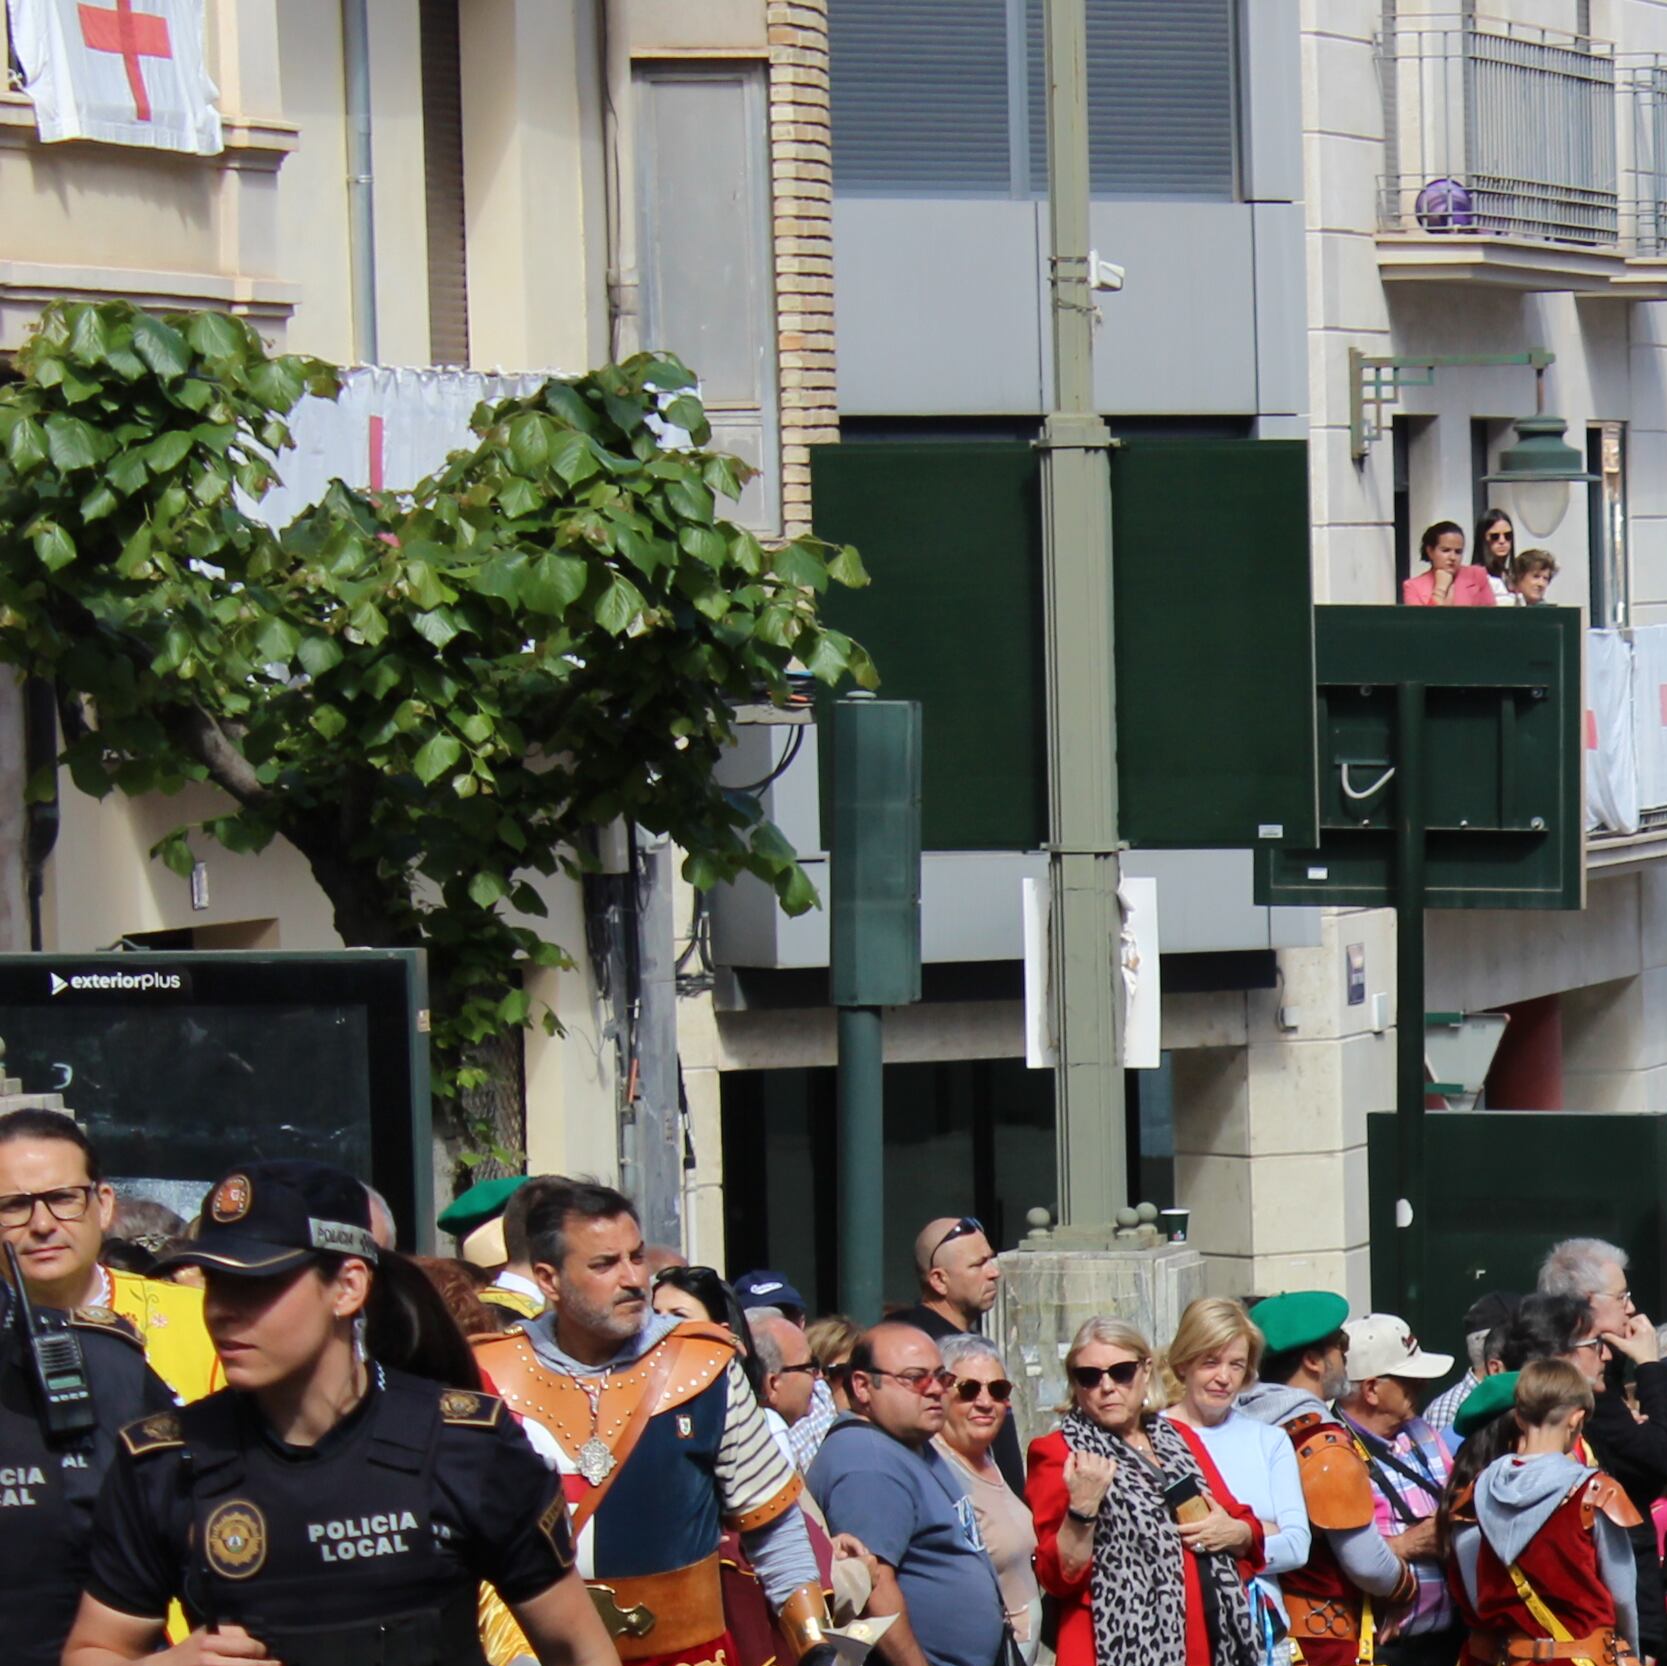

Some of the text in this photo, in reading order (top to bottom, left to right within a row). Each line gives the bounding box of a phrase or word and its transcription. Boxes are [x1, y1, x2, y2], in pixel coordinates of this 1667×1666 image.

[70, 972, 181, 990] exteriorplus
[308, 1511, 418, 1542] POLICIA
[321, 1534, 410, 1562] LOCAL
